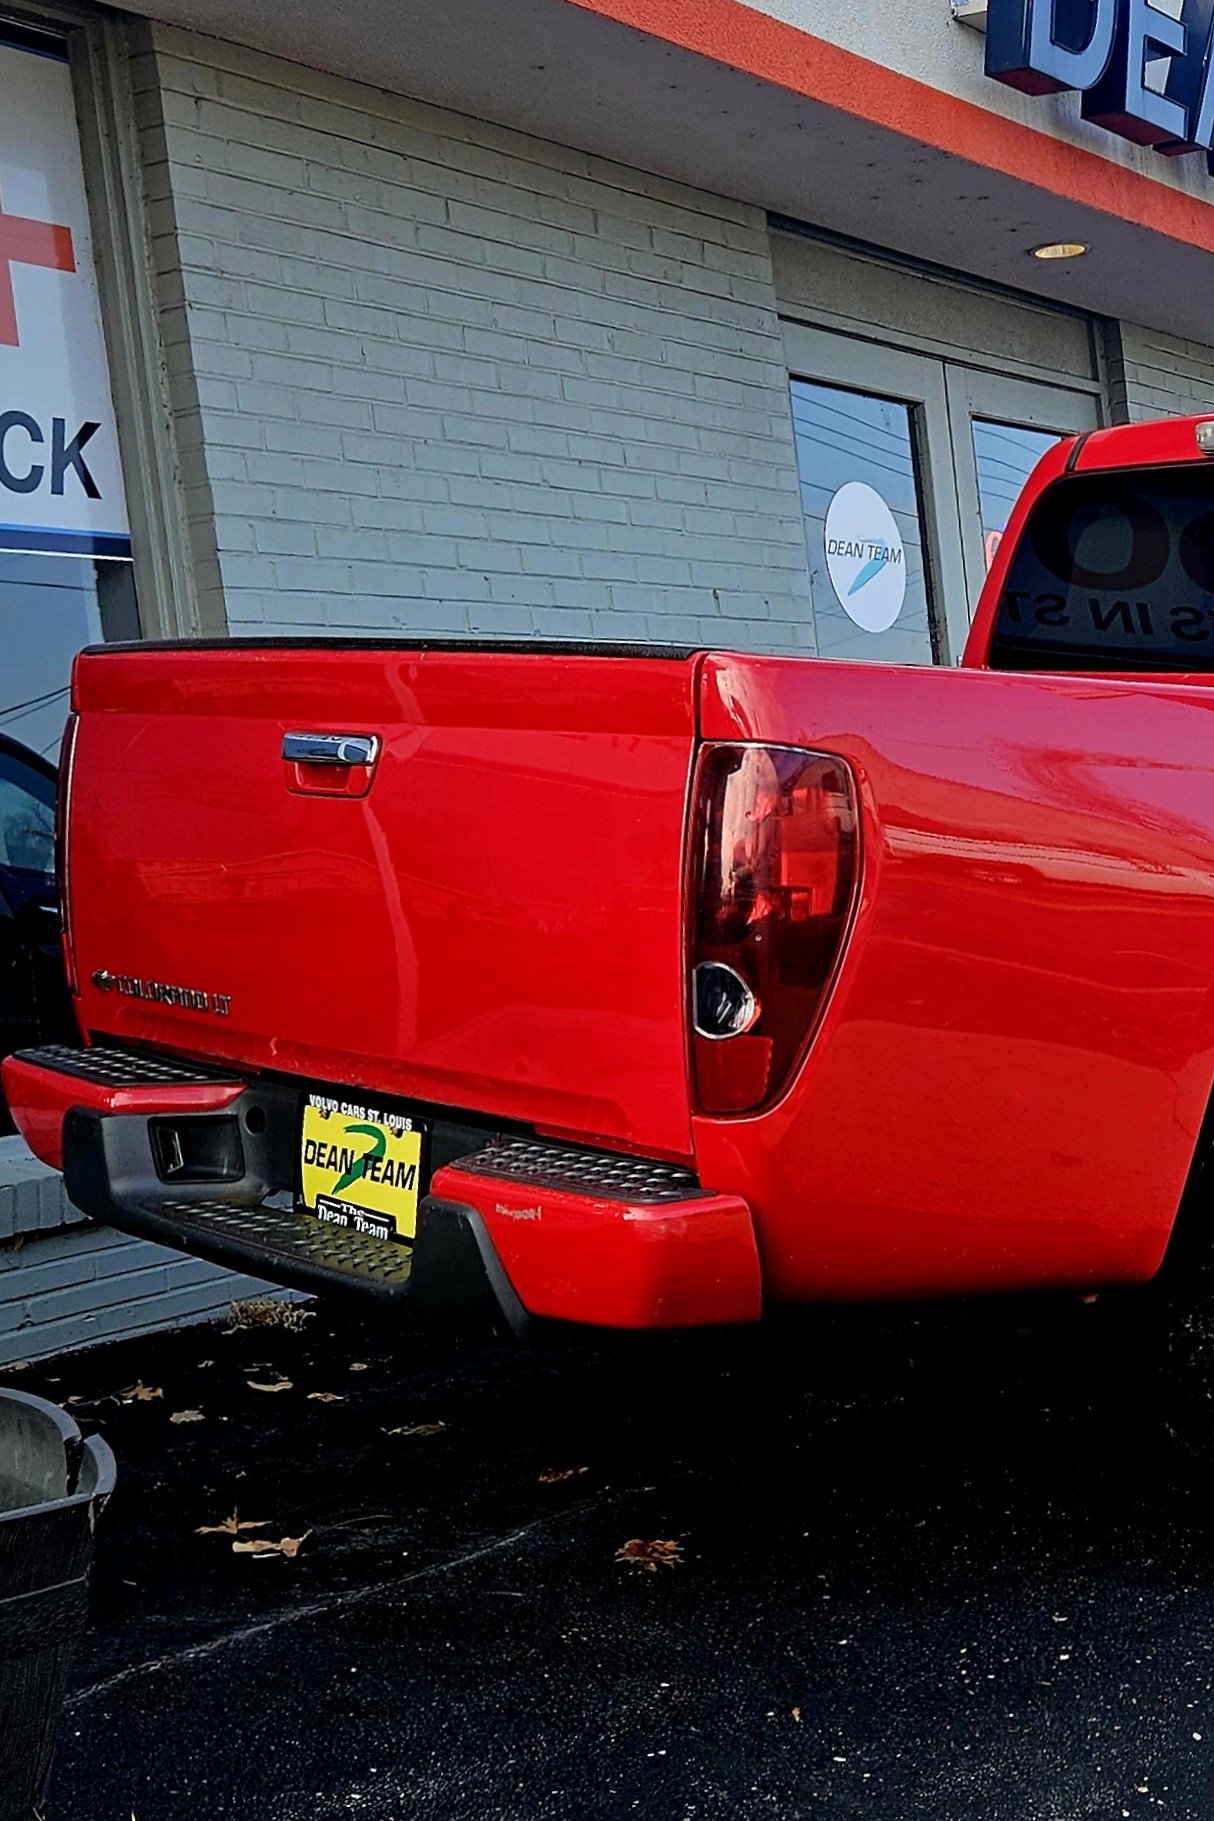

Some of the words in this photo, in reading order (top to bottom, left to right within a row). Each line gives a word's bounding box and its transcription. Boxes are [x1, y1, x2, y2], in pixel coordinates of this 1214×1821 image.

[828, 539, 863, 559] DEAN
[867, 544, 902, 564] TEAM
[117, 975, 208, 1012] COLORADO
[212, 993, 231, 1015] LT
[309, 1094, 339, 1112] VOLVO
[340, 1102, 366, 1118] CARS
[367, 1108, 381, 1123] ST.
[383, 1113, 413, 1131] LOUIS
[304, 1138, 355, 1175] DEAN
[361, 1152, 417, 1191] TEAM
[317, 1204, 348, 1227] Dean
[353, 1216, 389, 1241] Team
